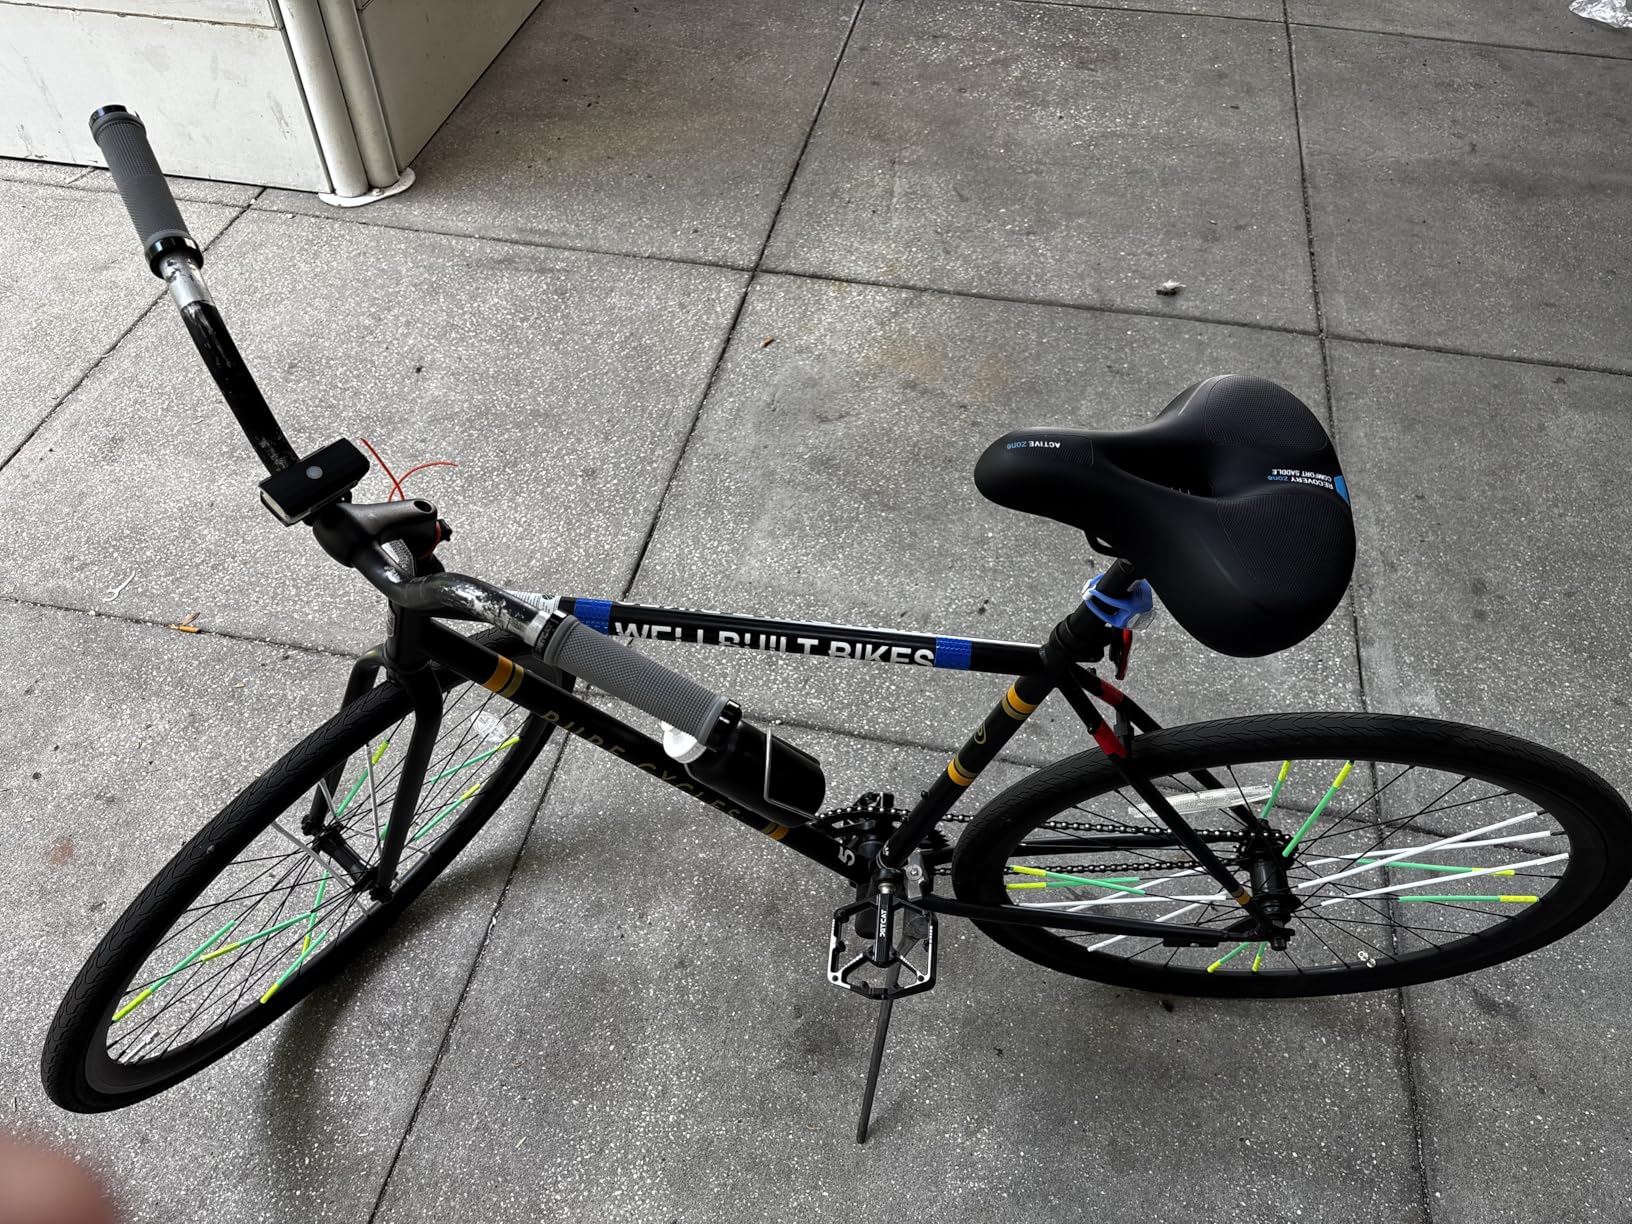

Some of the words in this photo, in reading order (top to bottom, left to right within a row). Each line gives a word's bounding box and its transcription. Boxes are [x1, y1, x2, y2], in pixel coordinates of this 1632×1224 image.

[1028, 440, 1061, 449] ACTIVE
[1271, 468, 1300, 477] SADDLE
[1301, 470, 1332, 482] COMFORT
[1290, 476, 1334, 490] RECOVERY
